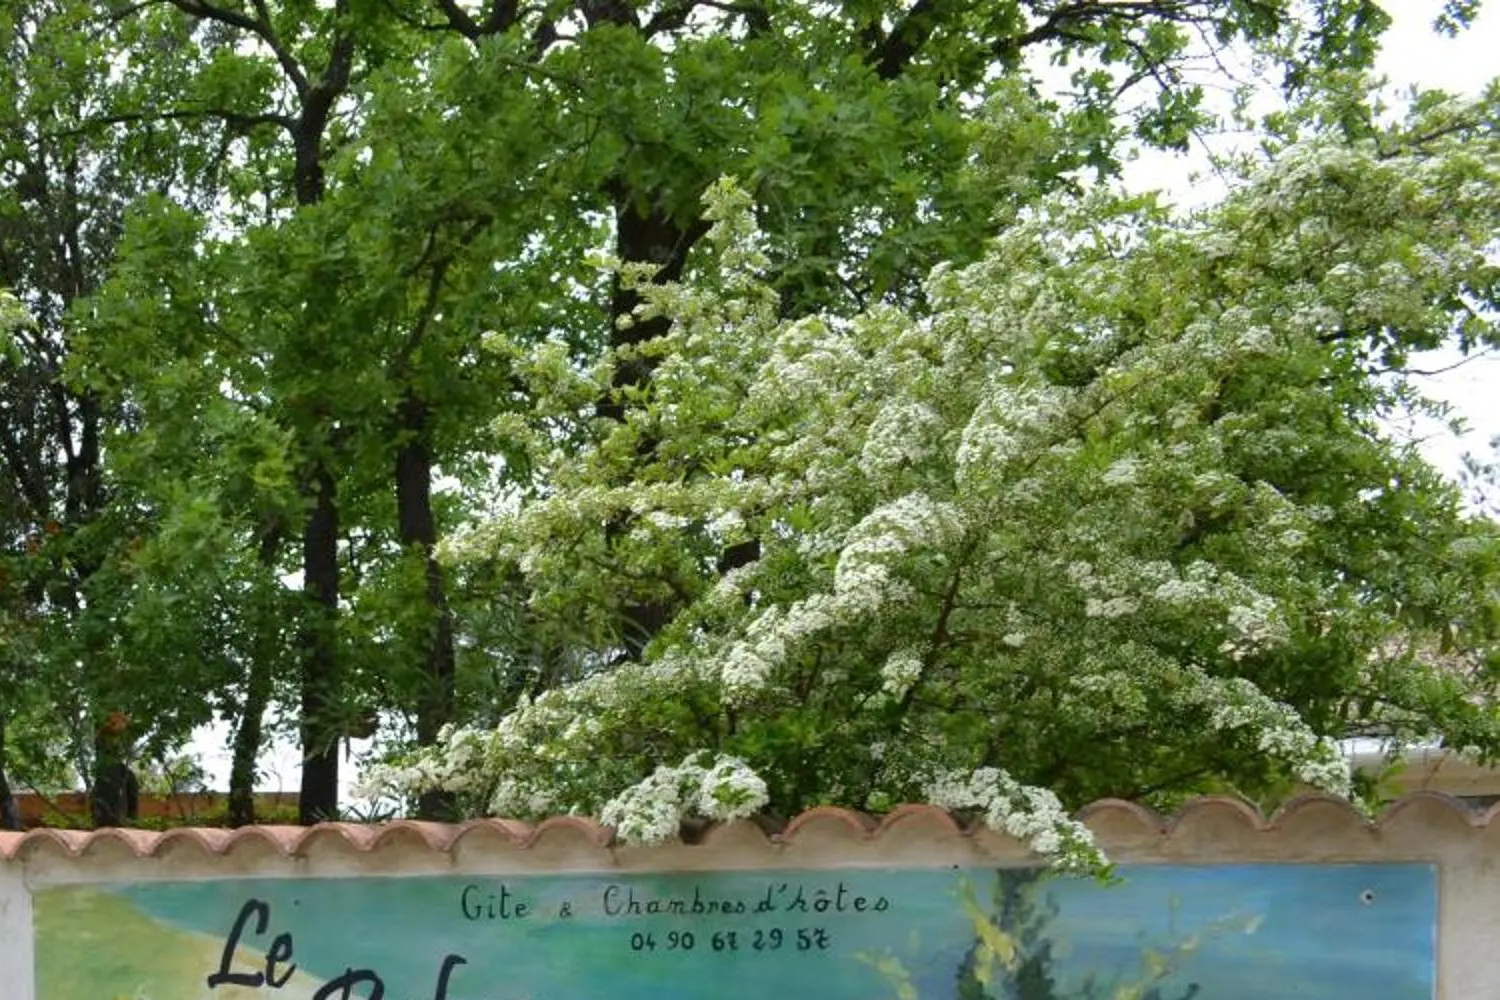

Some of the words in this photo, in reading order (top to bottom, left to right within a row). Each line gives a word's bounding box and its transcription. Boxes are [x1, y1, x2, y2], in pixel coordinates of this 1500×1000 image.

[558, 900, 573, 918] &
[603, 885, 746, 916] Chambres
[753, 881, 890, 913] d'hôtes
[206, 897, 298, 989] Le
[631, 931, 656, 951] 04
[667, 930, 695, 950] 90
[711, 930, 739, 951] 67
[752, 928, 784, 950] 29
[797, 928, 832, 951] 57
